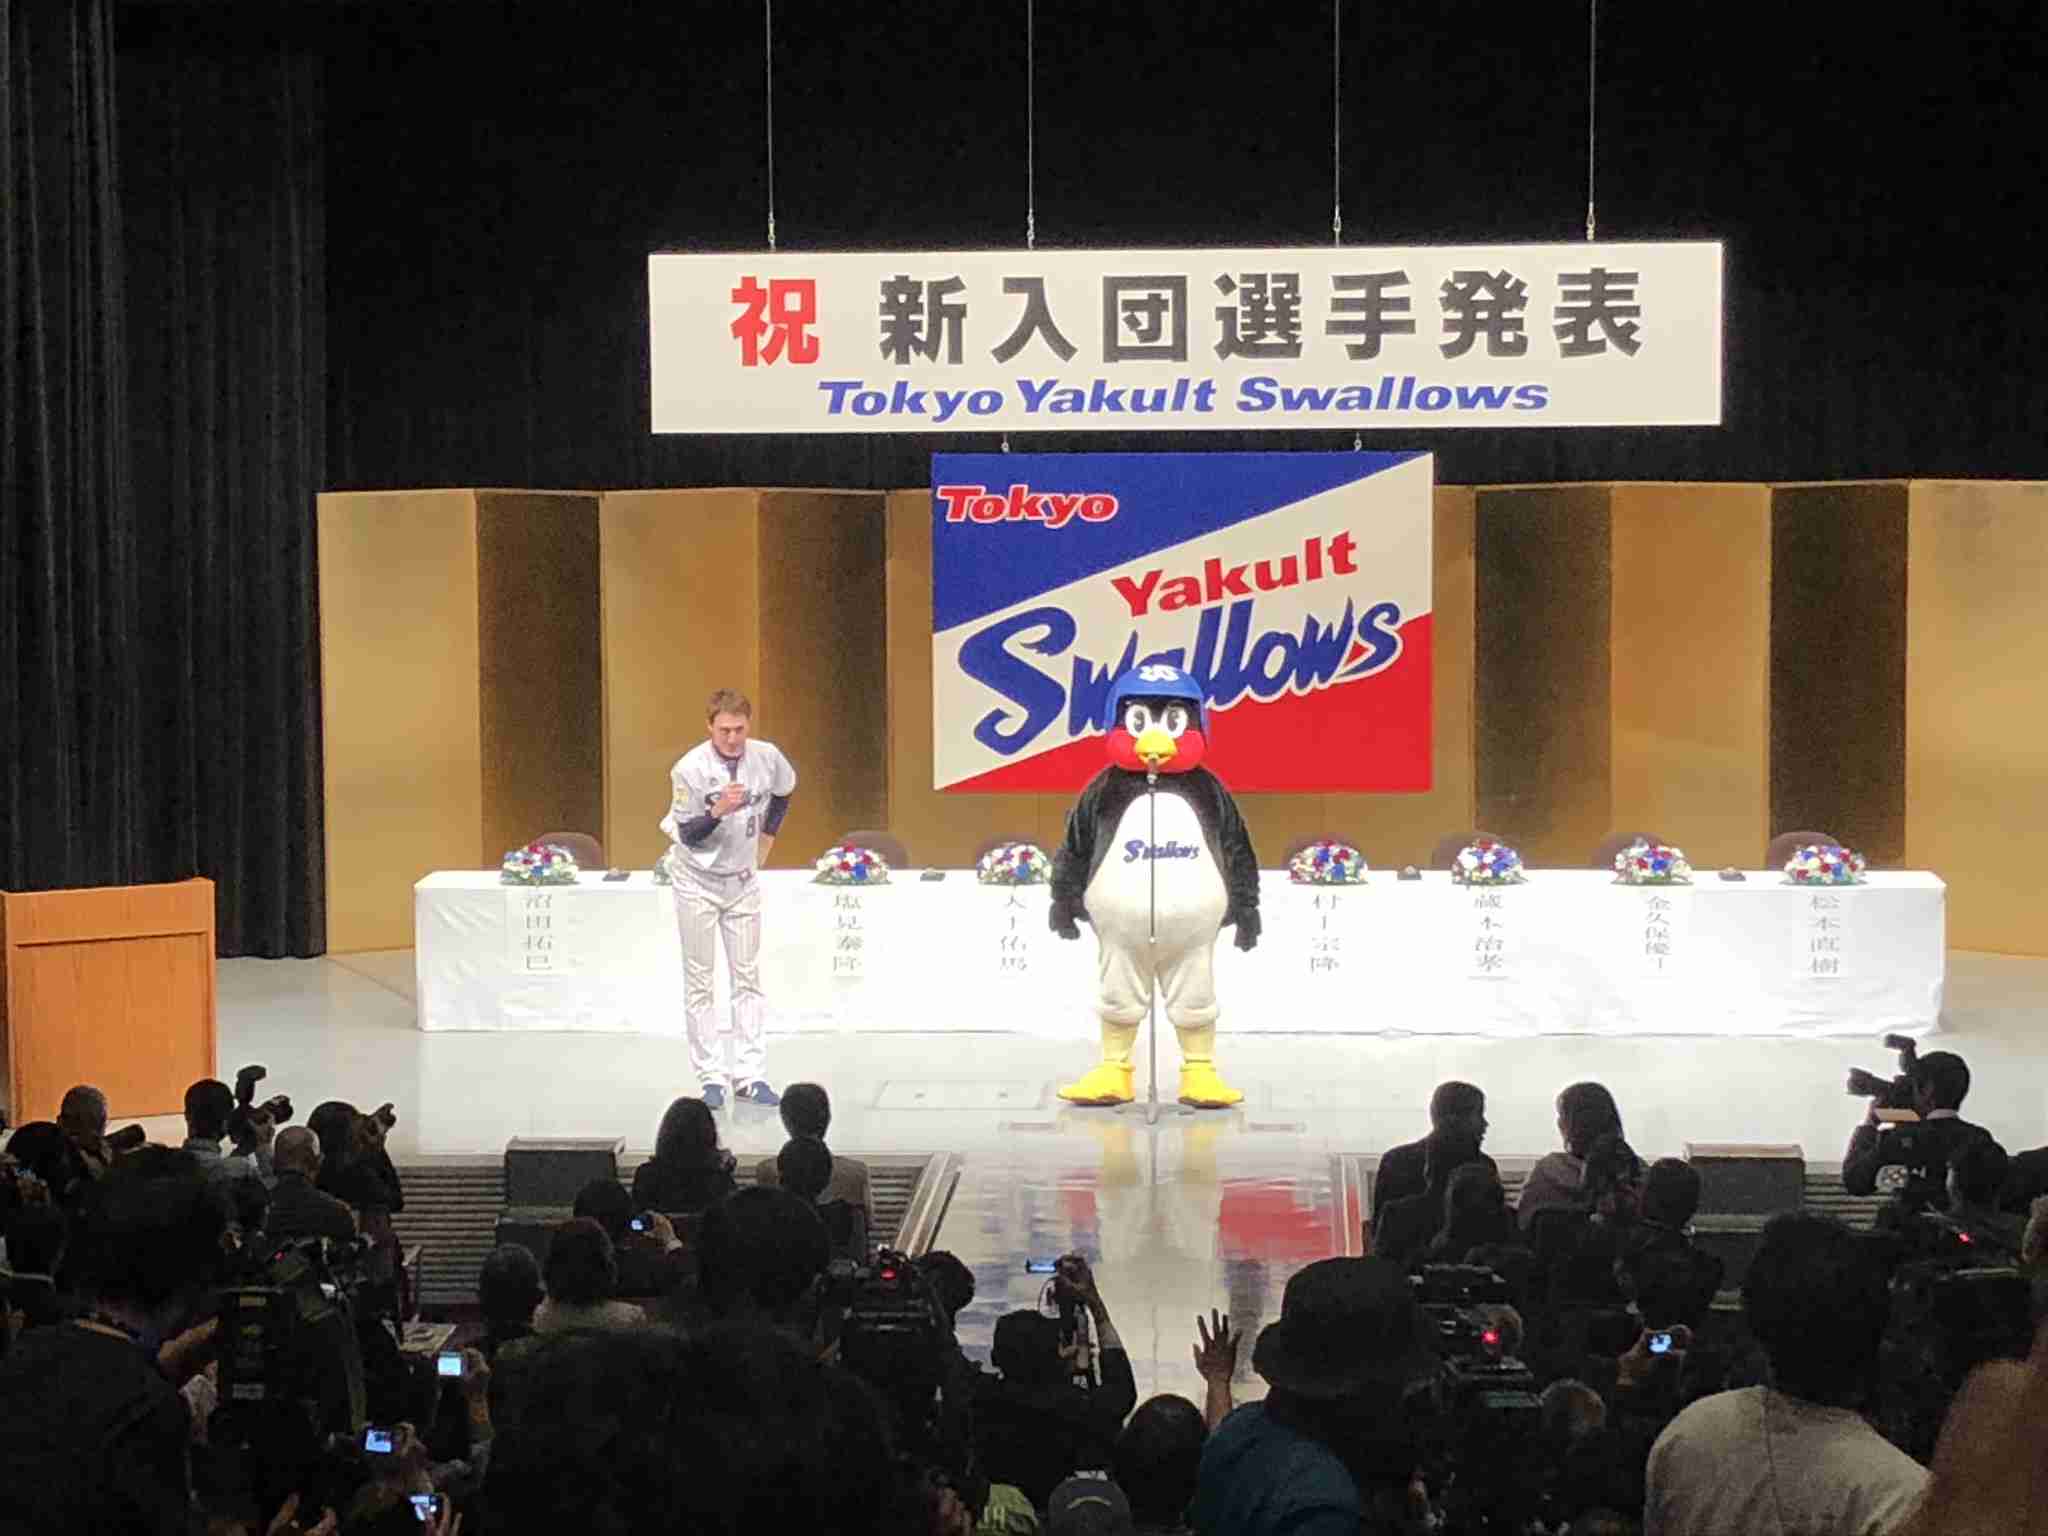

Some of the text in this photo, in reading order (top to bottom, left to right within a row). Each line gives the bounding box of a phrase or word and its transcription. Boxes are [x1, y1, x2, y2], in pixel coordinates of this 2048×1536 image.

[730, 267, 1642, 367] 祝 新入団選手発表
[817, 375, 1549, 423] Tokyo Yakult Swallows
[937, 484, 1119, 529] Tokyo
[1110, 529, 1359, 618] Yakult
